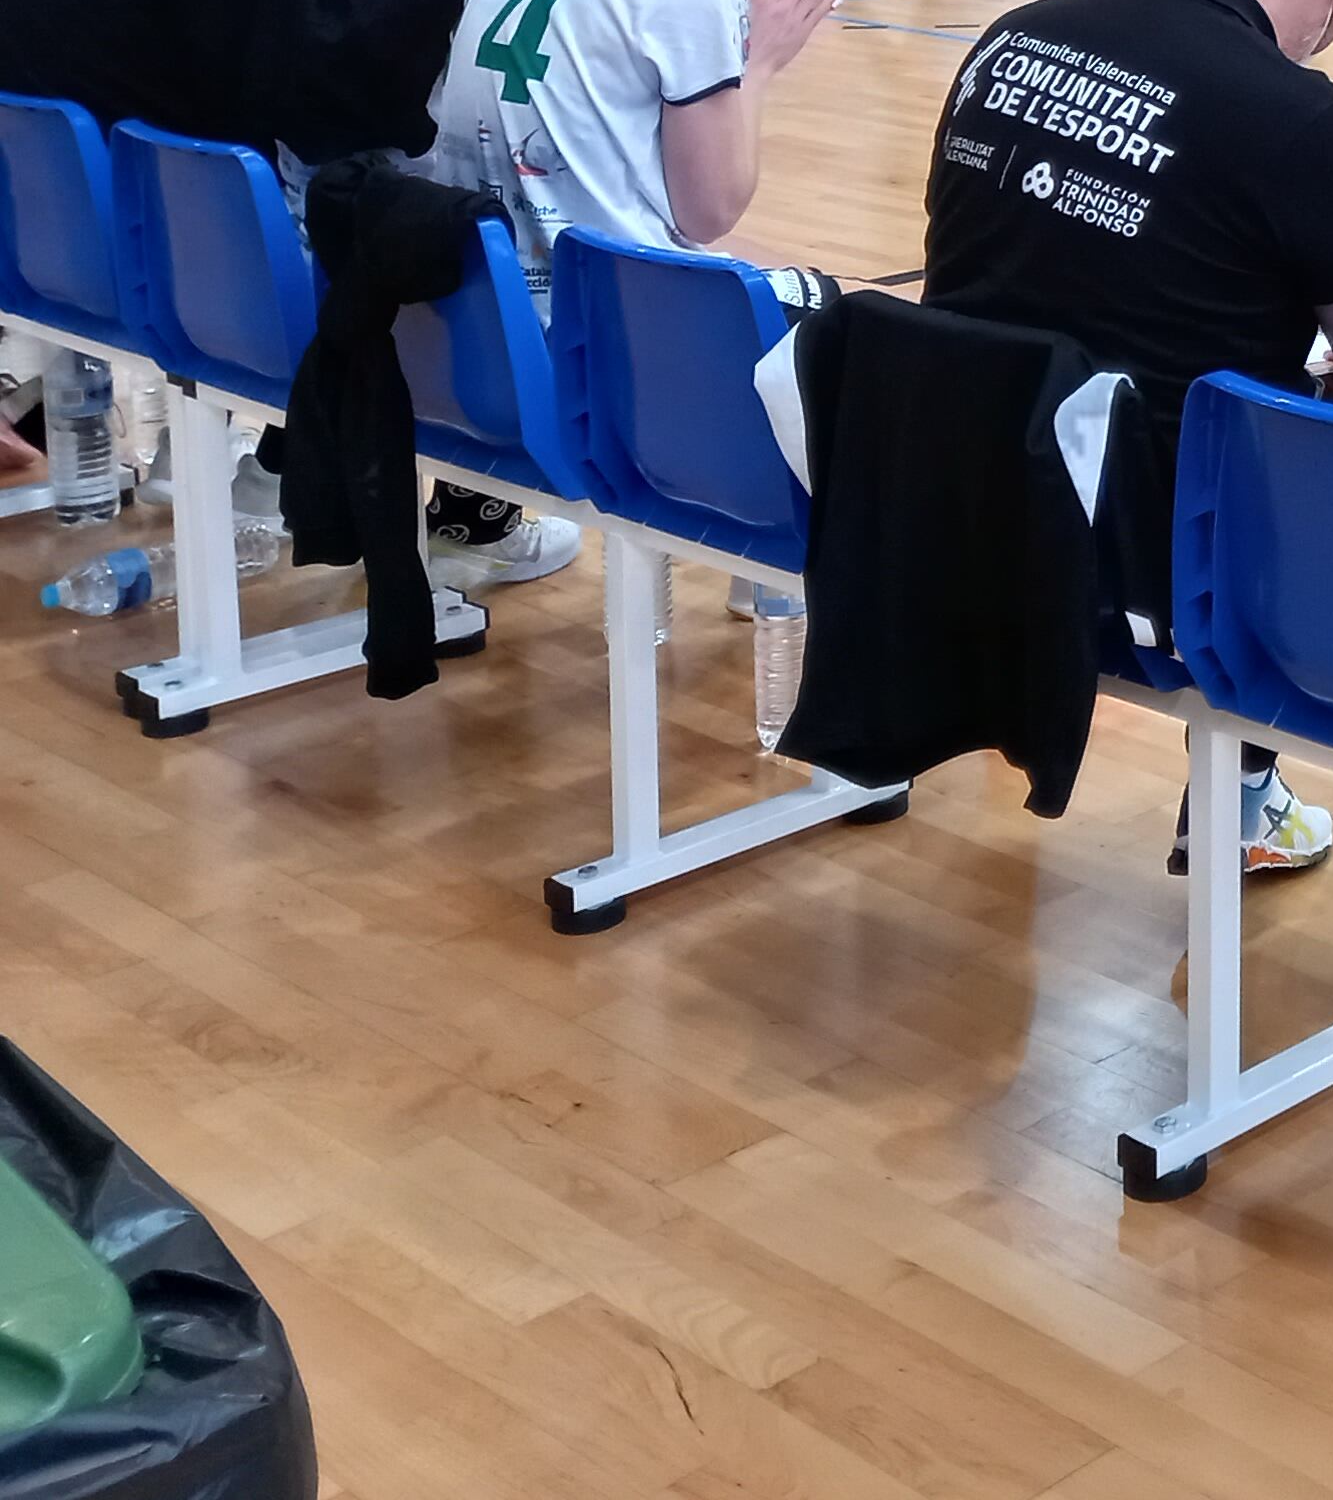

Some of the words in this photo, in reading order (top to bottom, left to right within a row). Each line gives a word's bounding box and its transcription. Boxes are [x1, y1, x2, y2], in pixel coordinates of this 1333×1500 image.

[991, 51, 1165, 132] COMUNITAT
[1009, 31, 1086, 67] Comunitat
[1085, 54, 1177, 106] Valenciana
[984, 82, 1026, 117] DE
[1023, 94, 1175, 174] L'ESPORT
[1059, 180, 1144, 223] TRINIDAD
[1066, 168, 1150, 208] FUNDACIÓN
[1052, 200, 1138, 237] ALFONSO
